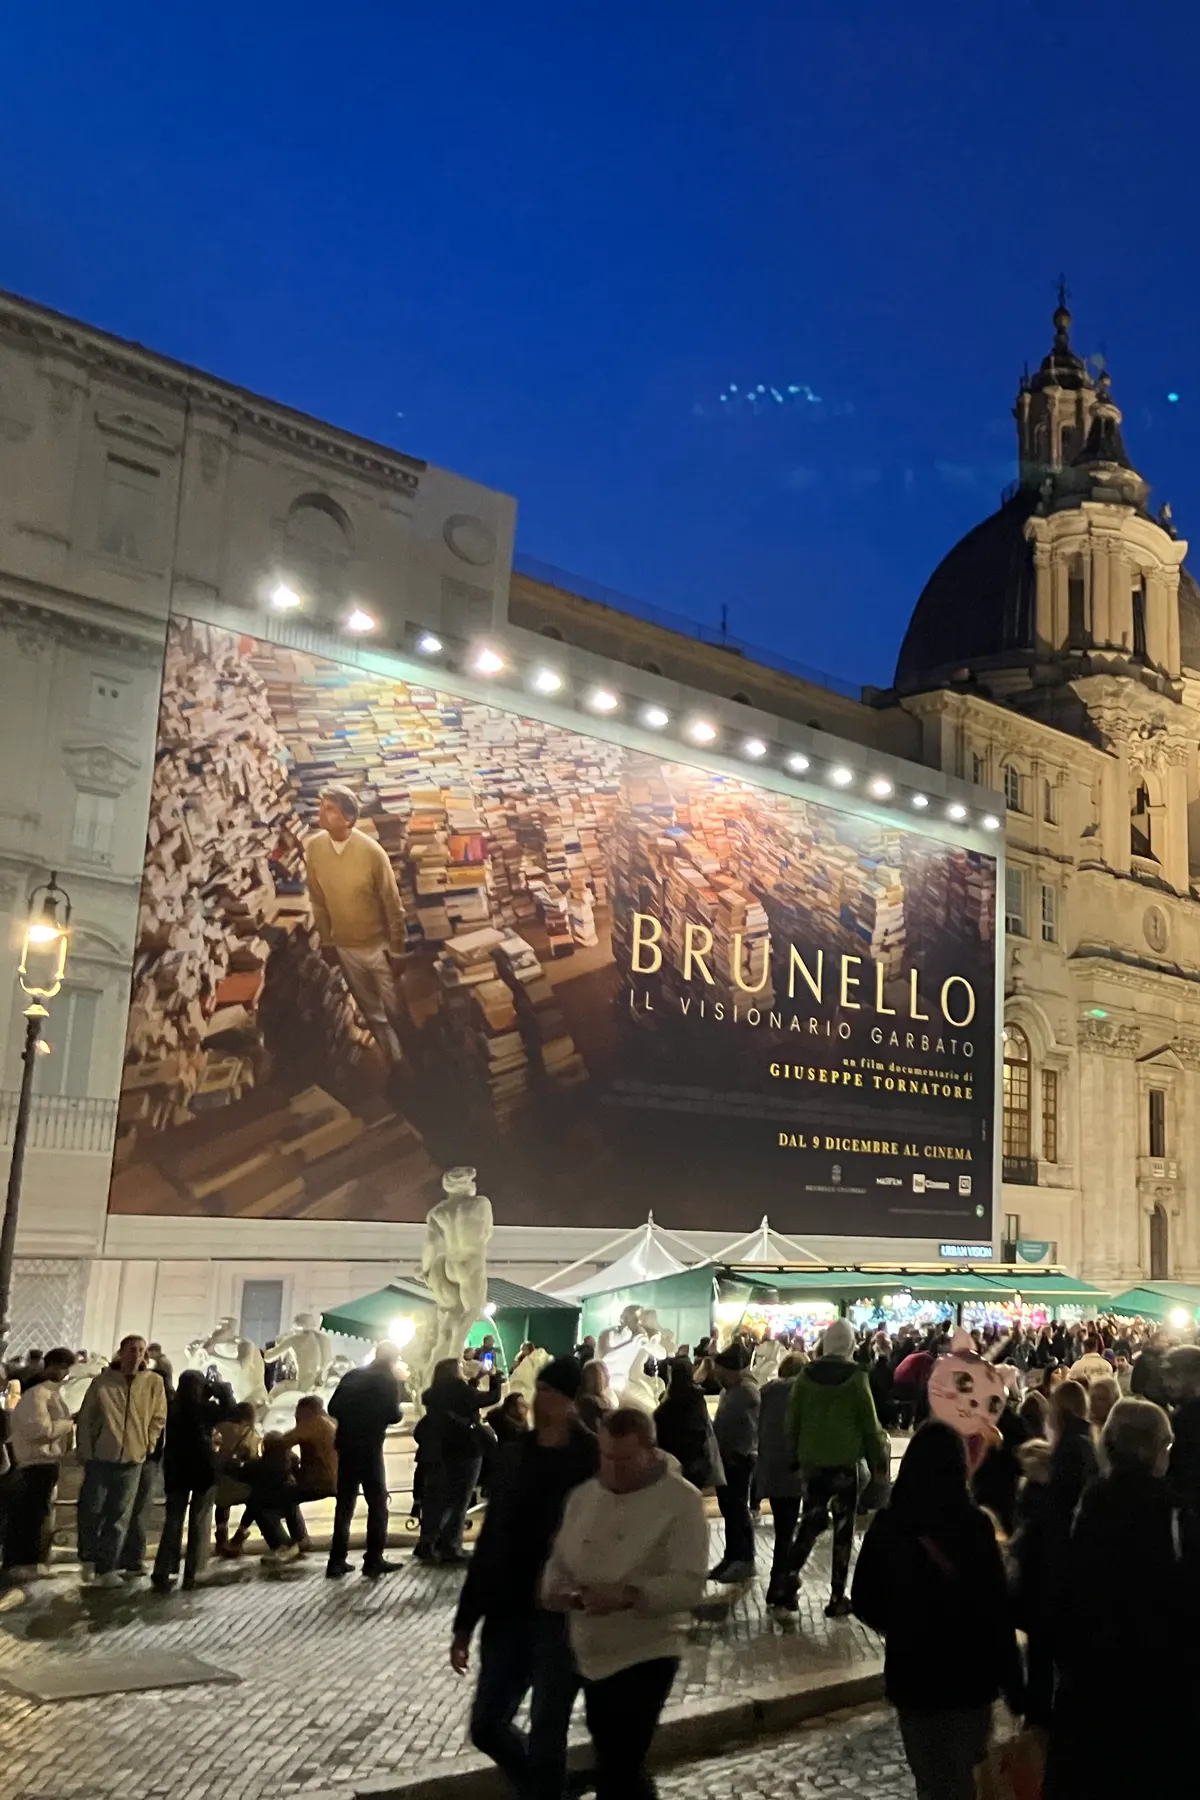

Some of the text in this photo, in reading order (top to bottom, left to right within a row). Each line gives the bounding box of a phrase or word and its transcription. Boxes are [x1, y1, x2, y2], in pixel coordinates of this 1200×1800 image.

[631, 912, 976, 1027] BRUNELLO
[630, 989, 975, 1057] IL VISIONARIO GARBATO
[769, 1062, 973, 1100] GIUSEPPE TORNATORE
[842, 1057, 973, 1082] un film documentario di
[778, 1132, 973, 1161] DAL 9 DICEMBRE AL CINEMA
